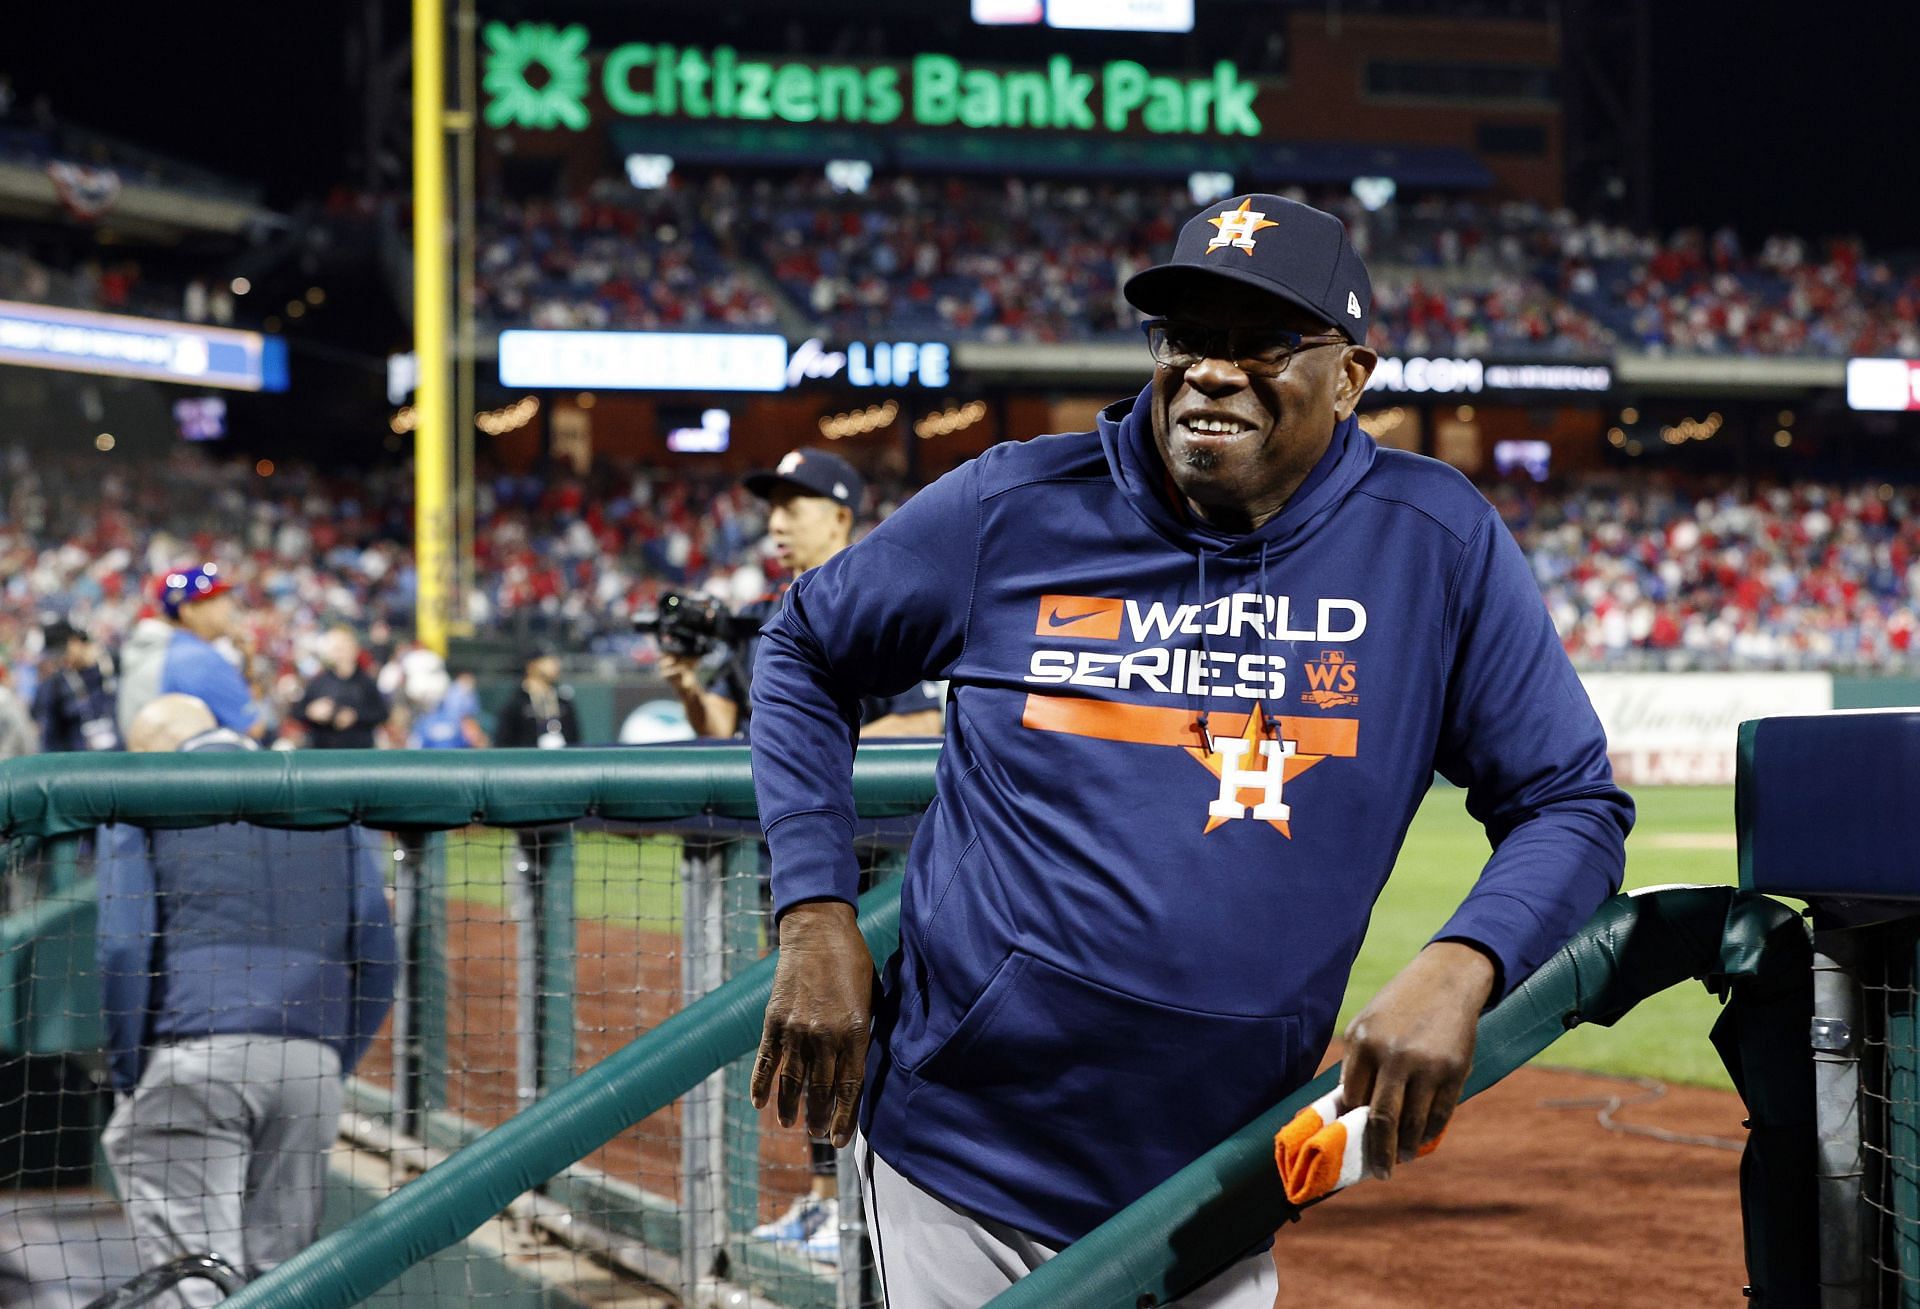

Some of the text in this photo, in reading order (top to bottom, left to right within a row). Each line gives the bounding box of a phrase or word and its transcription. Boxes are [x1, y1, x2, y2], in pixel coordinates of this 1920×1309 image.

[602, 42, 1263, 137] Citizens Bank Park
[1209, 210, 1266, 249] H
[847, 340, 950, 388] LIFE
[1125, 593, 1367, 643] WORLD
[1023, 647, 1287, 700] SERIES
[1304, 663, 1357, 693] WS
[1208, 737, 1297, 821] H
